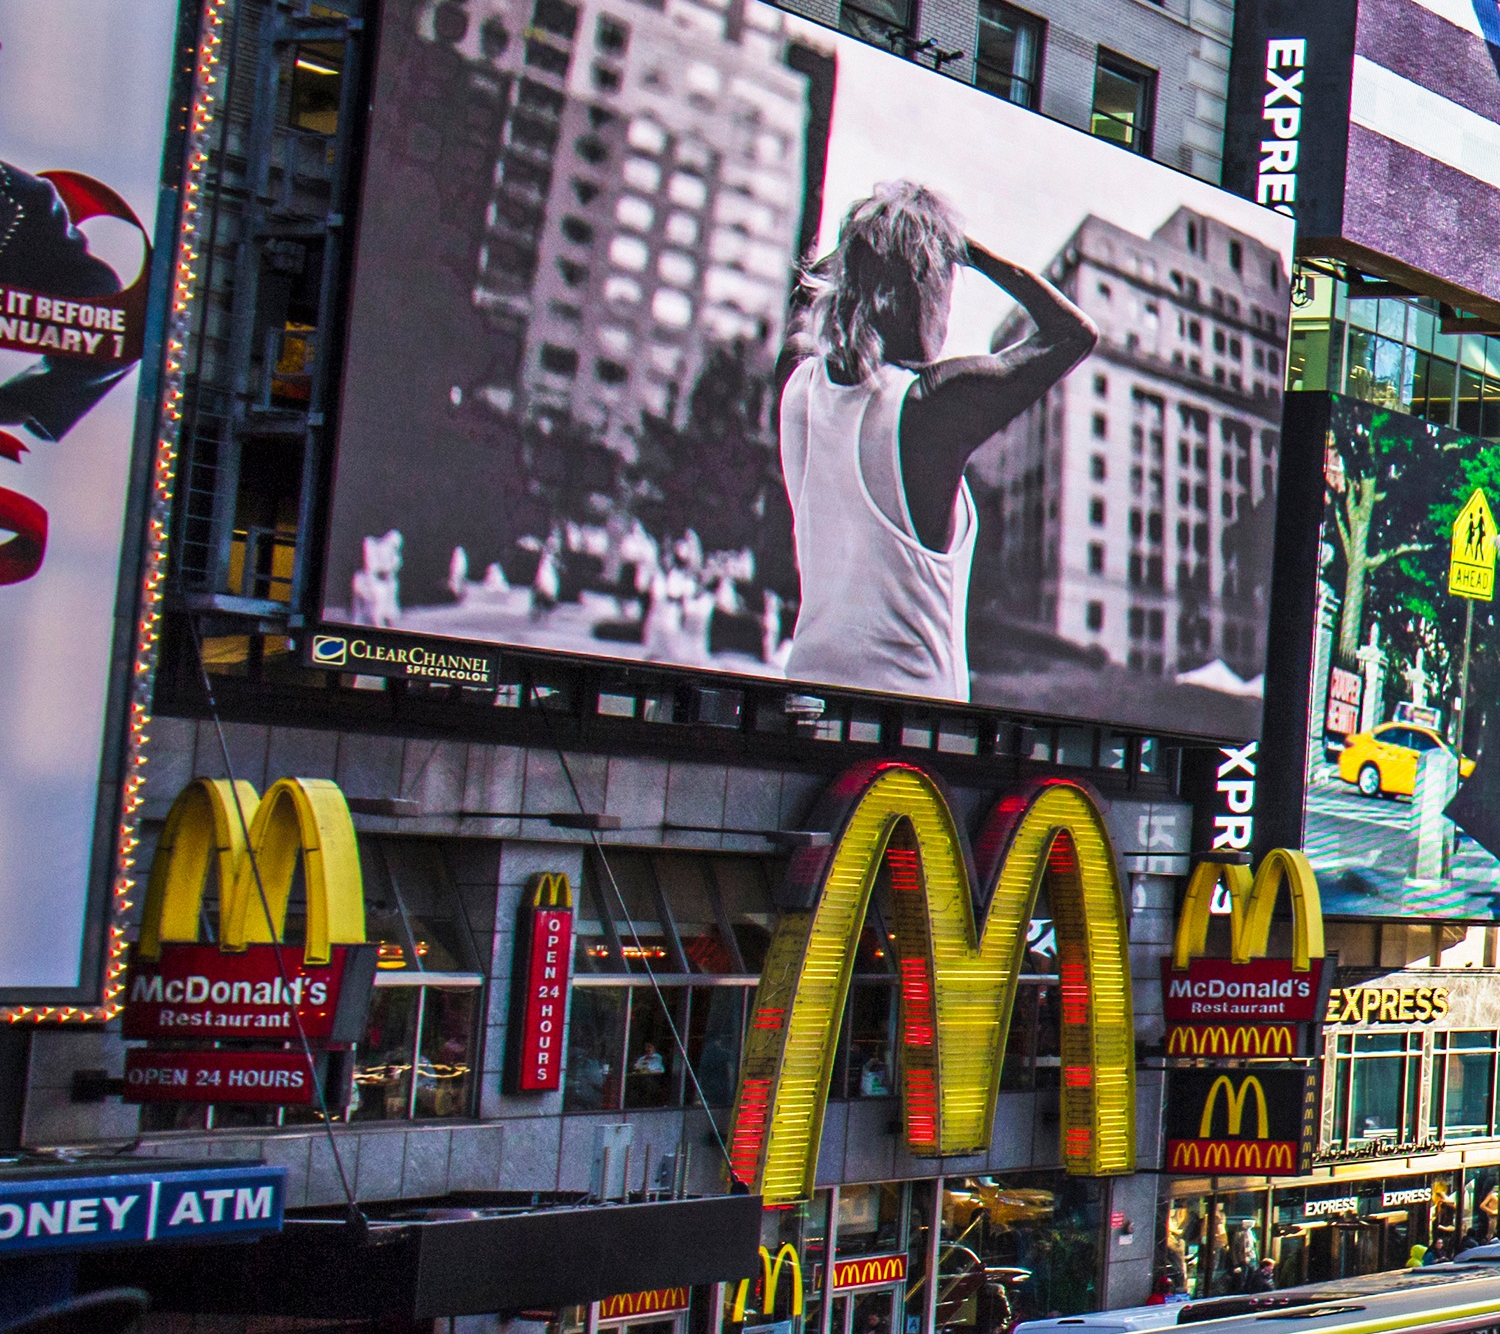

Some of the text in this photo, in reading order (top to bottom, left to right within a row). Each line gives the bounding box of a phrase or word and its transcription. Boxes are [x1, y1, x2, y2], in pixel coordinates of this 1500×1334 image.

[37, 297, 125, 332] BEFORE
[1456, 568, 1487, 590] AHEAD
[405, 664, 489, 683] SPECTACOLOR
[132, 977, 329, 1004] McDonald's
[1170, 978, 1310, 999] McDonald's
[1191, 1001, 1285, 1014] Restaurant
[1326, 987, 1449, 1023] EXPRESS
[160, 1010, 290, 1028] Restaurant
[128, 1068, 304, 1089] OPEN 24 HOURS
[169, 1187, 273, 1226] ATM
[1305, 1197, 1358, 1216] EXPRESS
